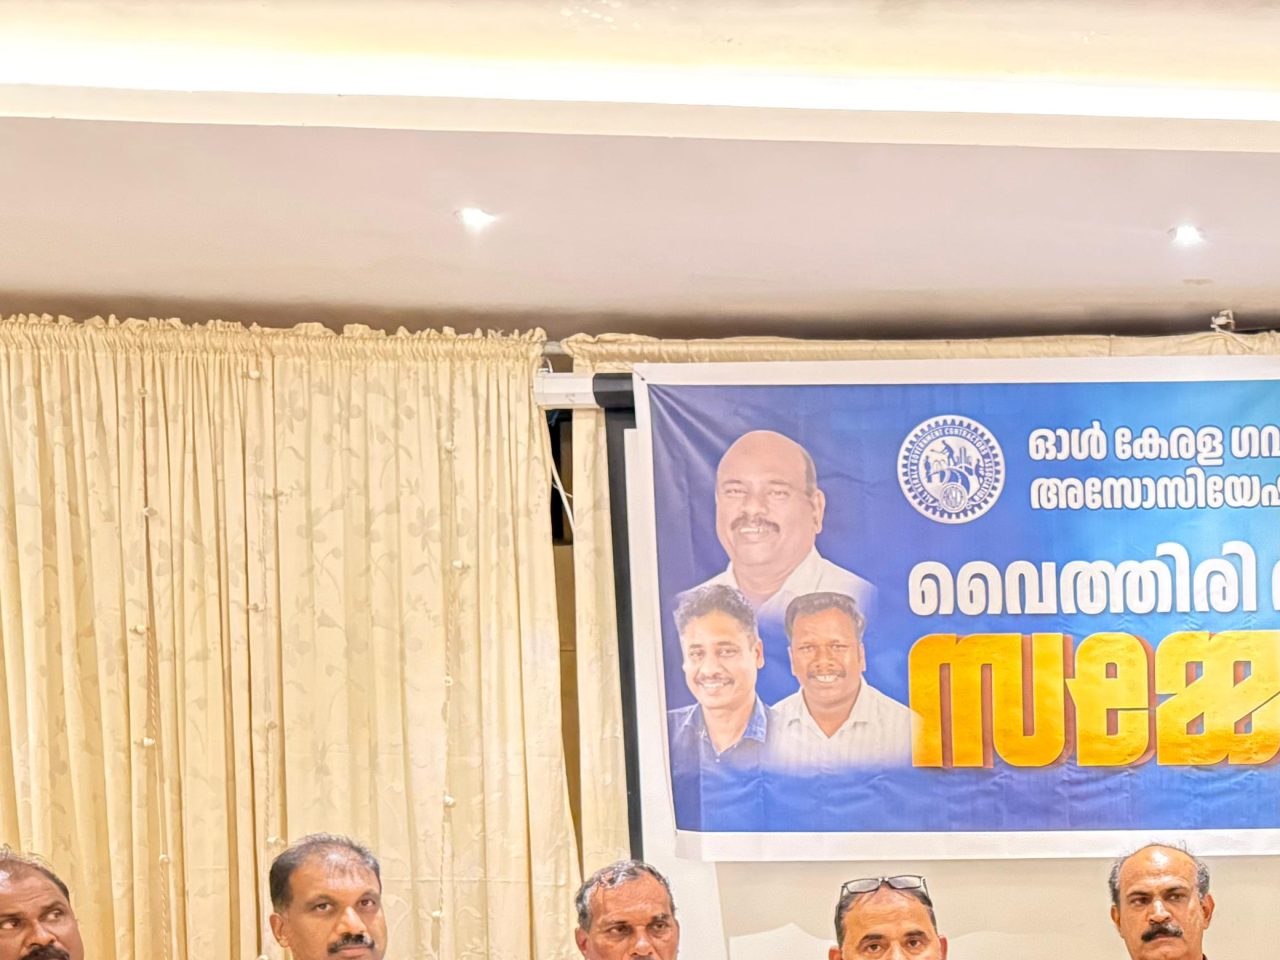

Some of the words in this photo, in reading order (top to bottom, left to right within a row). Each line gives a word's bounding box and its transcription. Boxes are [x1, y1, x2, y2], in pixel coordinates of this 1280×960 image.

[911, 429, 944, 463] GOVERNMENT
[944, 428, 988, 455] CONTRACTORS
[1028, 420, 1107, 460] ഓൾ
[1114, 426, 1224, 466] കേരള
[907, 541, 1256, 616] വൈത്തിരി
